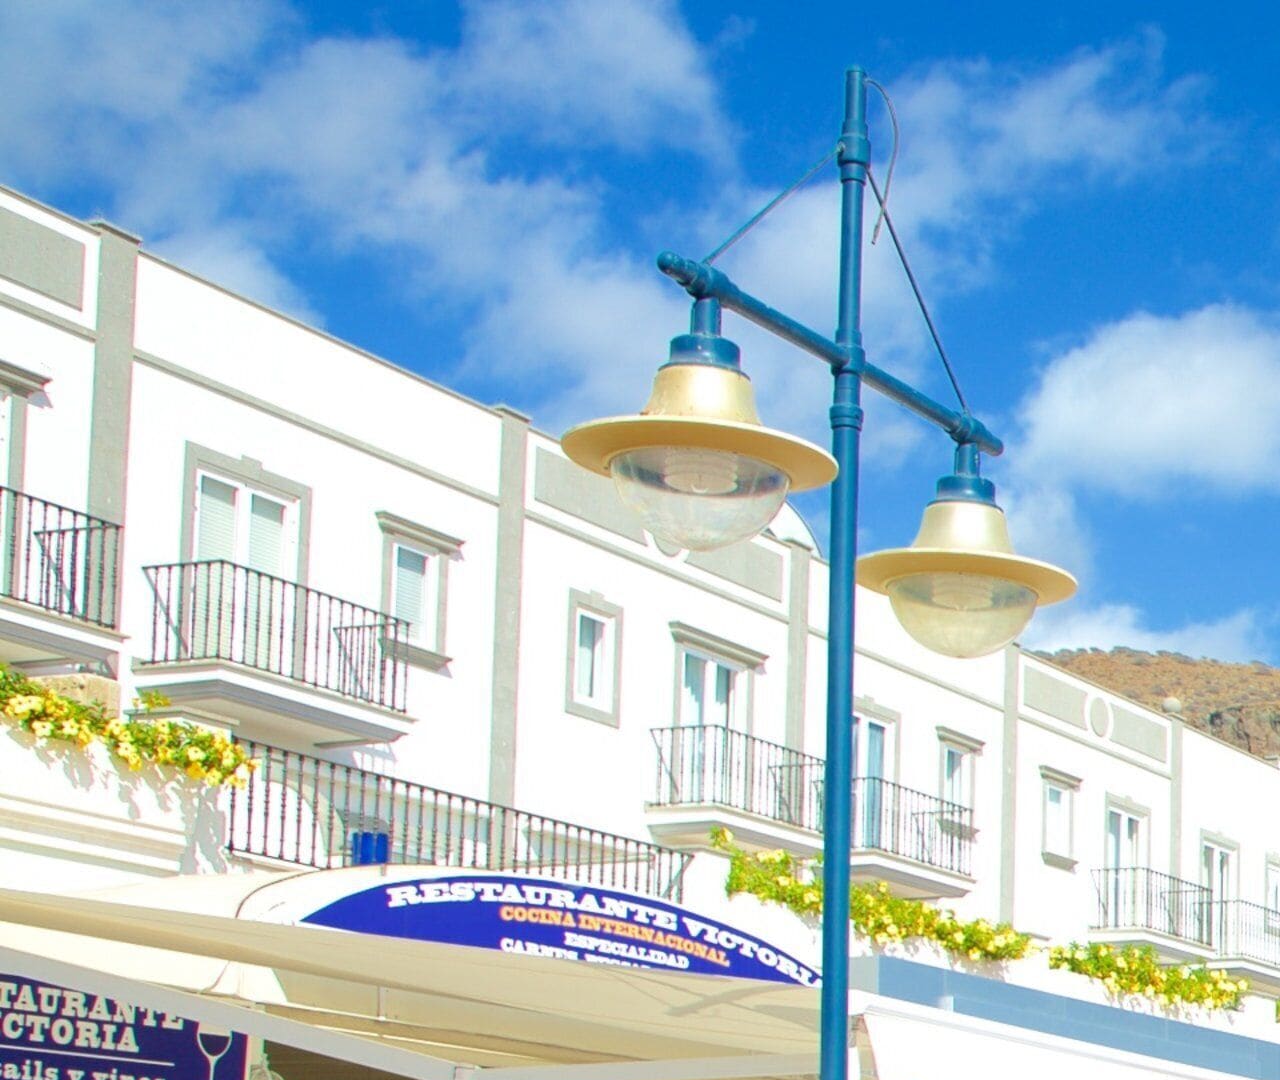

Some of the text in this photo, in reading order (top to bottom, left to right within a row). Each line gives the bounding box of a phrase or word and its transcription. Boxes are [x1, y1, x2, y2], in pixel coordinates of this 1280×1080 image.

[386, 882, 677, 931] RESTAURANTE
[500, 906, 576, 927] COCINA
[579, 914, 730, 967] INTERNACIONAL
[564, 931, 690, 969] ESPECIALIDAD
[0, 1012, 139, 1053] CTORIA
